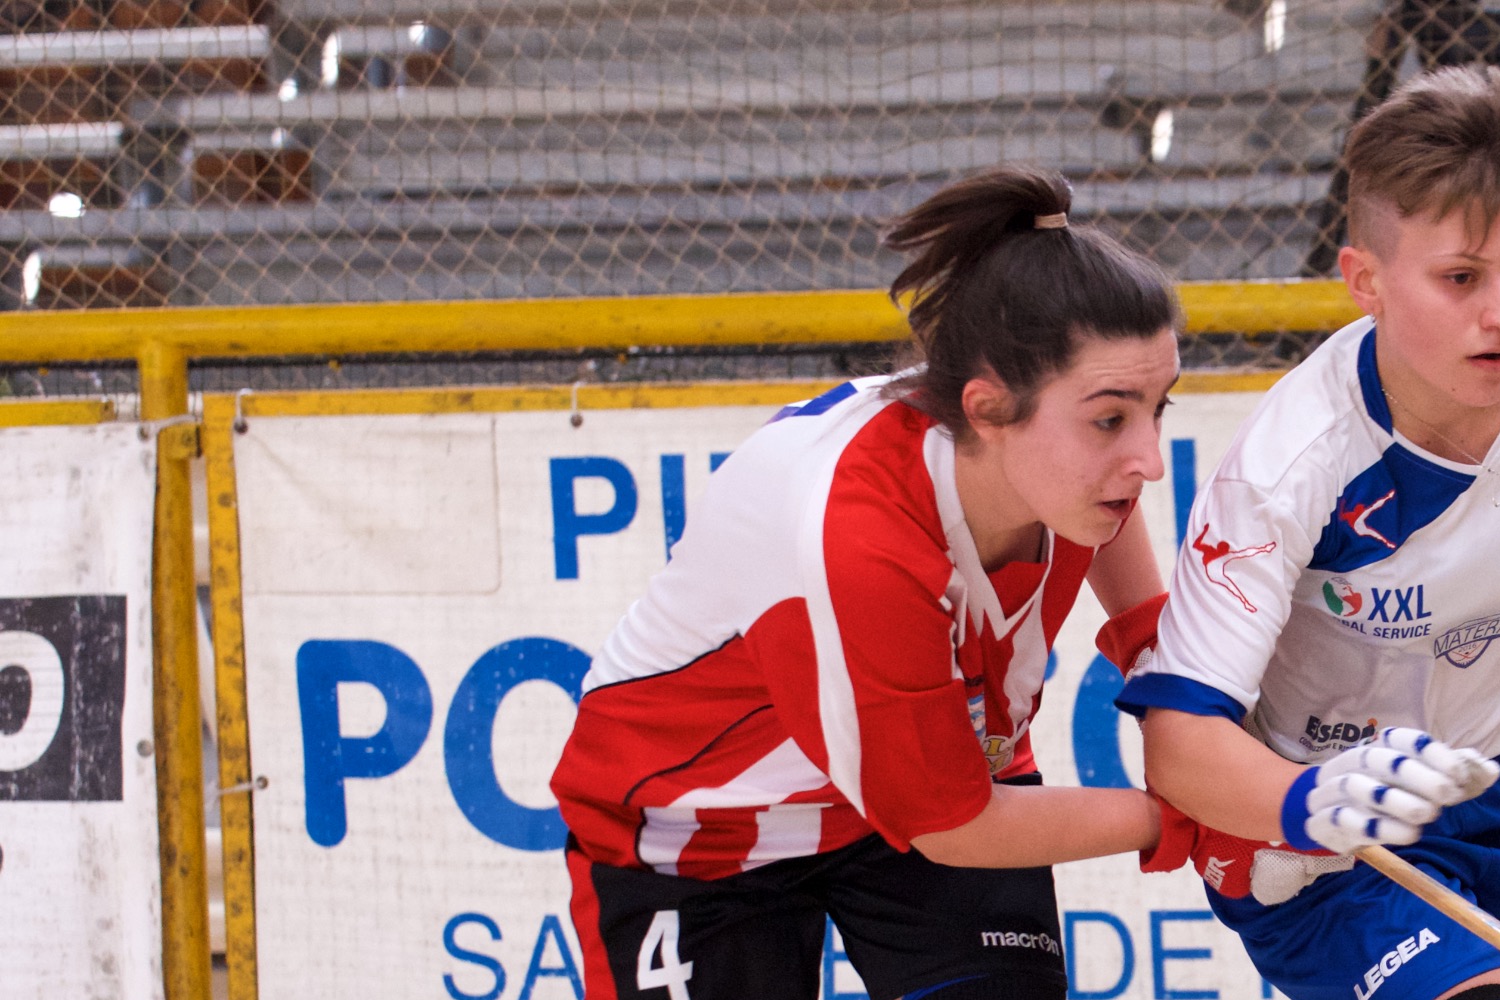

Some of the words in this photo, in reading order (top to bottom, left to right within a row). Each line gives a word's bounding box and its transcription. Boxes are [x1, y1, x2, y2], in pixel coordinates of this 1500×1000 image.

[1367, 584, 1432, 623] XXL
[1373, 623, 1432, 640] SERVICE
[981, 931, 1060, 957] macron
